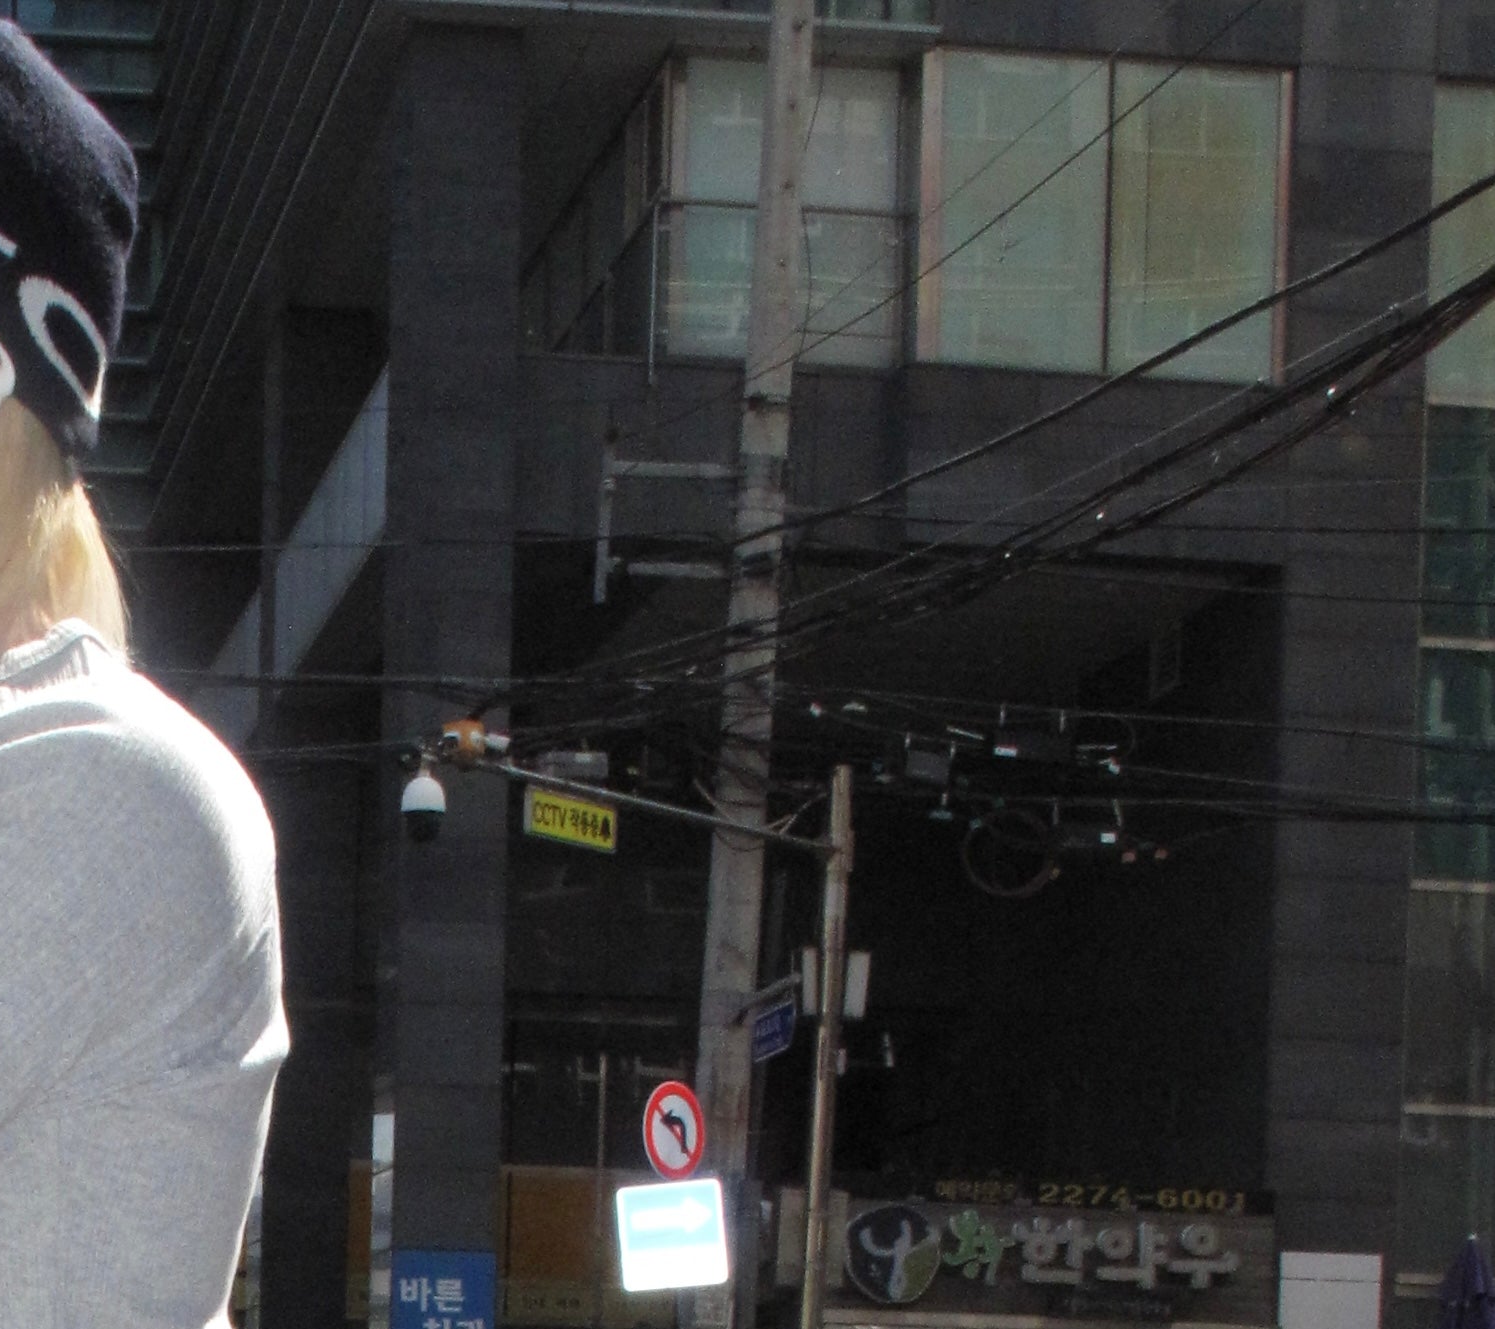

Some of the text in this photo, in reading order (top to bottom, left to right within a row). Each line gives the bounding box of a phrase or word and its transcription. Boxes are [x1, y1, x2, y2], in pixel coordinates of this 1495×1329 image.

[534, 801, 567, 829] CCTV
[1037, 1181, 1246, 1213] 2274-6001
[1011, 1215, 1242, 1290] 한약우
[399, 1276, 466, 1313] 바른
